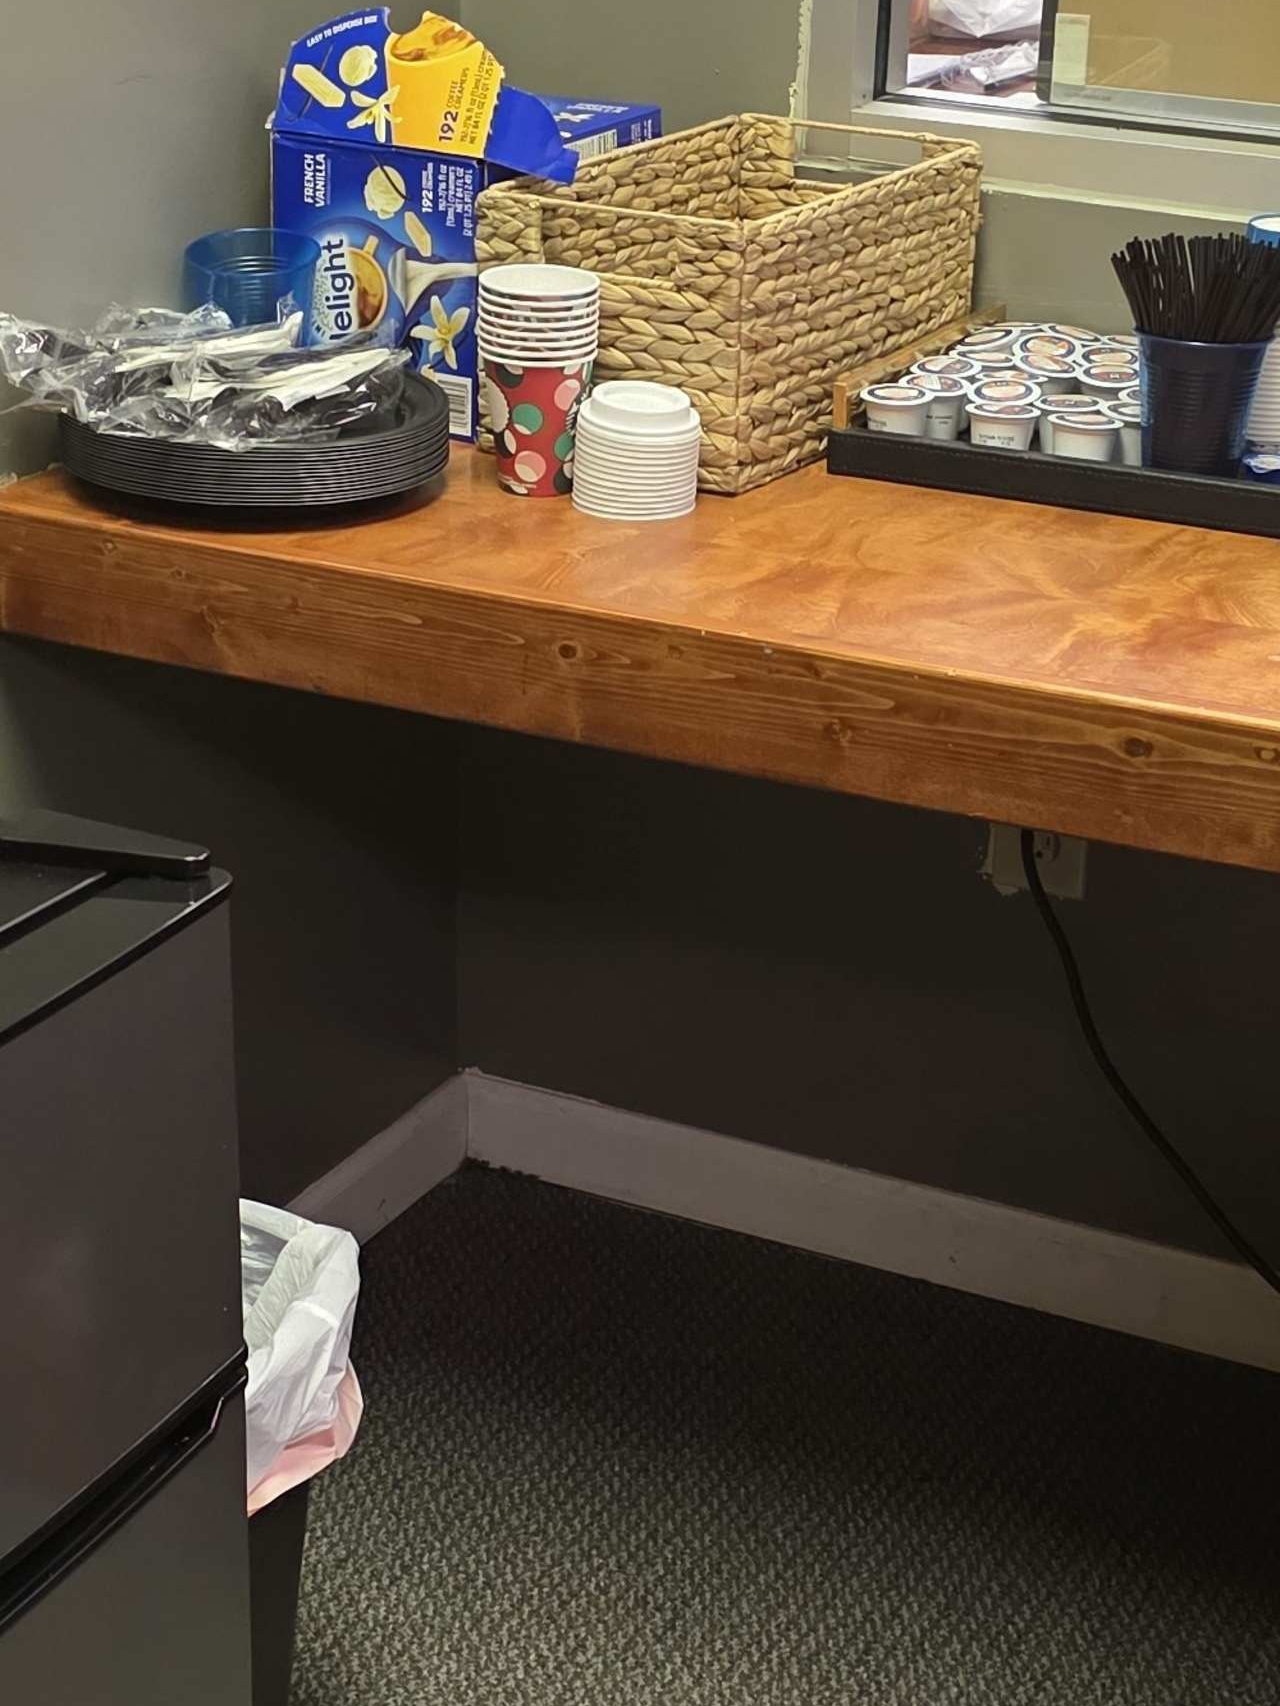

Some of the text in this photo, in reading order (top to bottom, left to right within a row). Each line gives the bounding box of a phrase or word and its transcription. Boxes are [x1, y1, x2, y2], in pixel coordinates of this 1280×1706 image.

[439, 110, 459, 142] 192
[304, 154, 314, 203] FRENCH
[314, 153, 326, 207] VANILLA
[422, 190, 433, 213] 192
